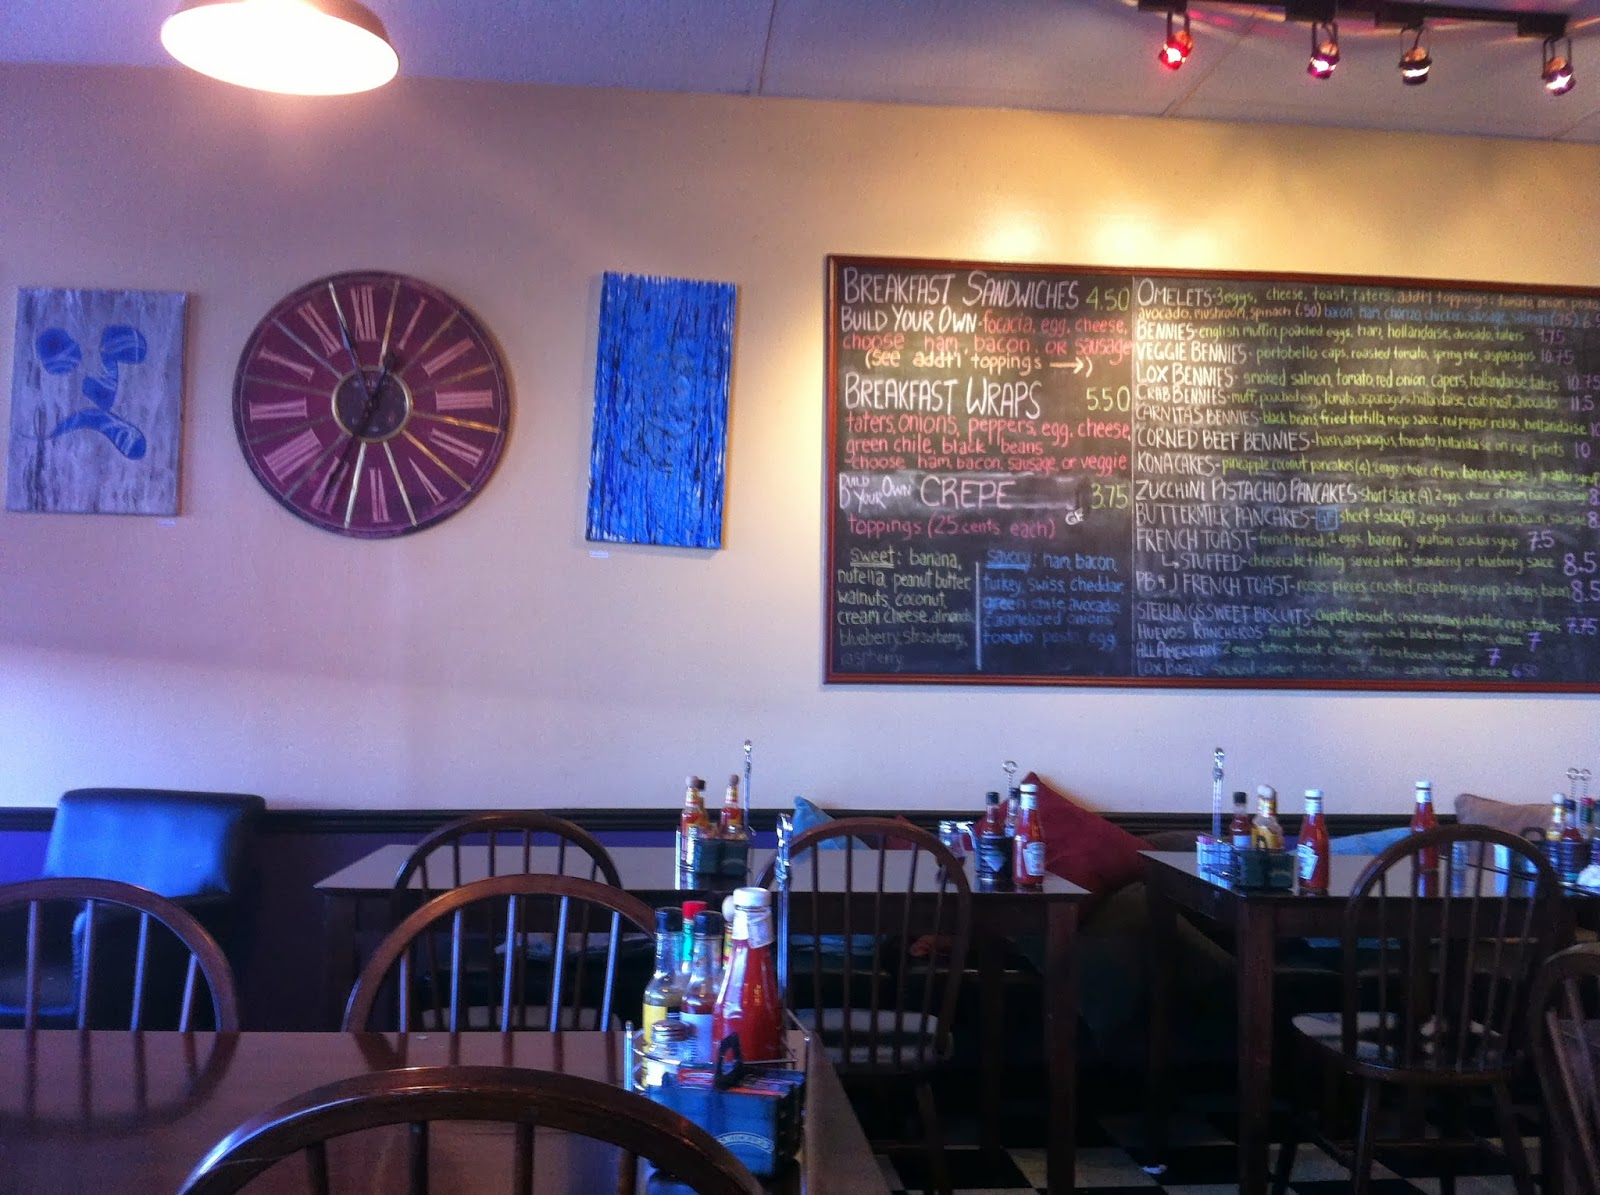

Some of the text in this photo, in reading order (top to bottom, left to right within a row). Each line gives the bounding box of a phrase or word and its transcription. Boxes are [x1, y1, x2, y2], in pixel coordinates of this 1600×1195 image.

[844, 267, 1130, 311] BREAKFAST SANDWICHES 4.50
[841, 305, 888, 332] BUILD
[892, 307, 934, 333] YOUR
[1075, 315, 1127, 335] cheese,
[843, 333, 905, 350] choose
[1200, 325, 1239, 341] english
[970, 352, 1042, 376] toppings
[1137, 341, 1187, 362] VEGGIE
[1136, 362, 1168, 384] LOX
[1376, 368, 1393, 388] red
[845, 371, 1130, 420] BREAKFAST WRAPS 5.50
[1137, 384, 1170, 401] CRAB
[1135, 403, 1203, 425] CARNITAS
[1320, 408, 1347, 425] fried
[968, 417, 1037, 446] peppers,
[1041, 422, 1073, 447] egg,
[1137, 425, 1199, 450] CORNED
[1203, 430, 1240, 450] BEEF
[846, 437, 888, 460] green
[942, 438, 987, 455] black
[1000, 438, 1043, 456] beans
[1062, 458, 1077, 471] or
[1081, 455, 1127, 477] veggie
[1137, 451, 1173, 474] KONA
[854, 488, 887, 513] YOUR
[882, 475, 912, 498] OWN
[920, 474, 1016, 510] CREPE
[1135, 479, 1206, 501] ZUCCHINI
[1211, 476, 1286, 503] PISTACHIO
[848, 513, 922, 540] toppings
[1010, 518, 1057, 539] each)
[1135, 502, 1230, 528] BUTTERMILK
[1136, 528, 1198, 552] FRENCH
[1563, 551, 1597, 576] 8.5
[893, 568, 933, 593] peanut
[1136, 570, 1156, 592] PB
[1183, 573, 1241, 597] FRENCH
[1137, 622, 1187, 641] HUEVOS
